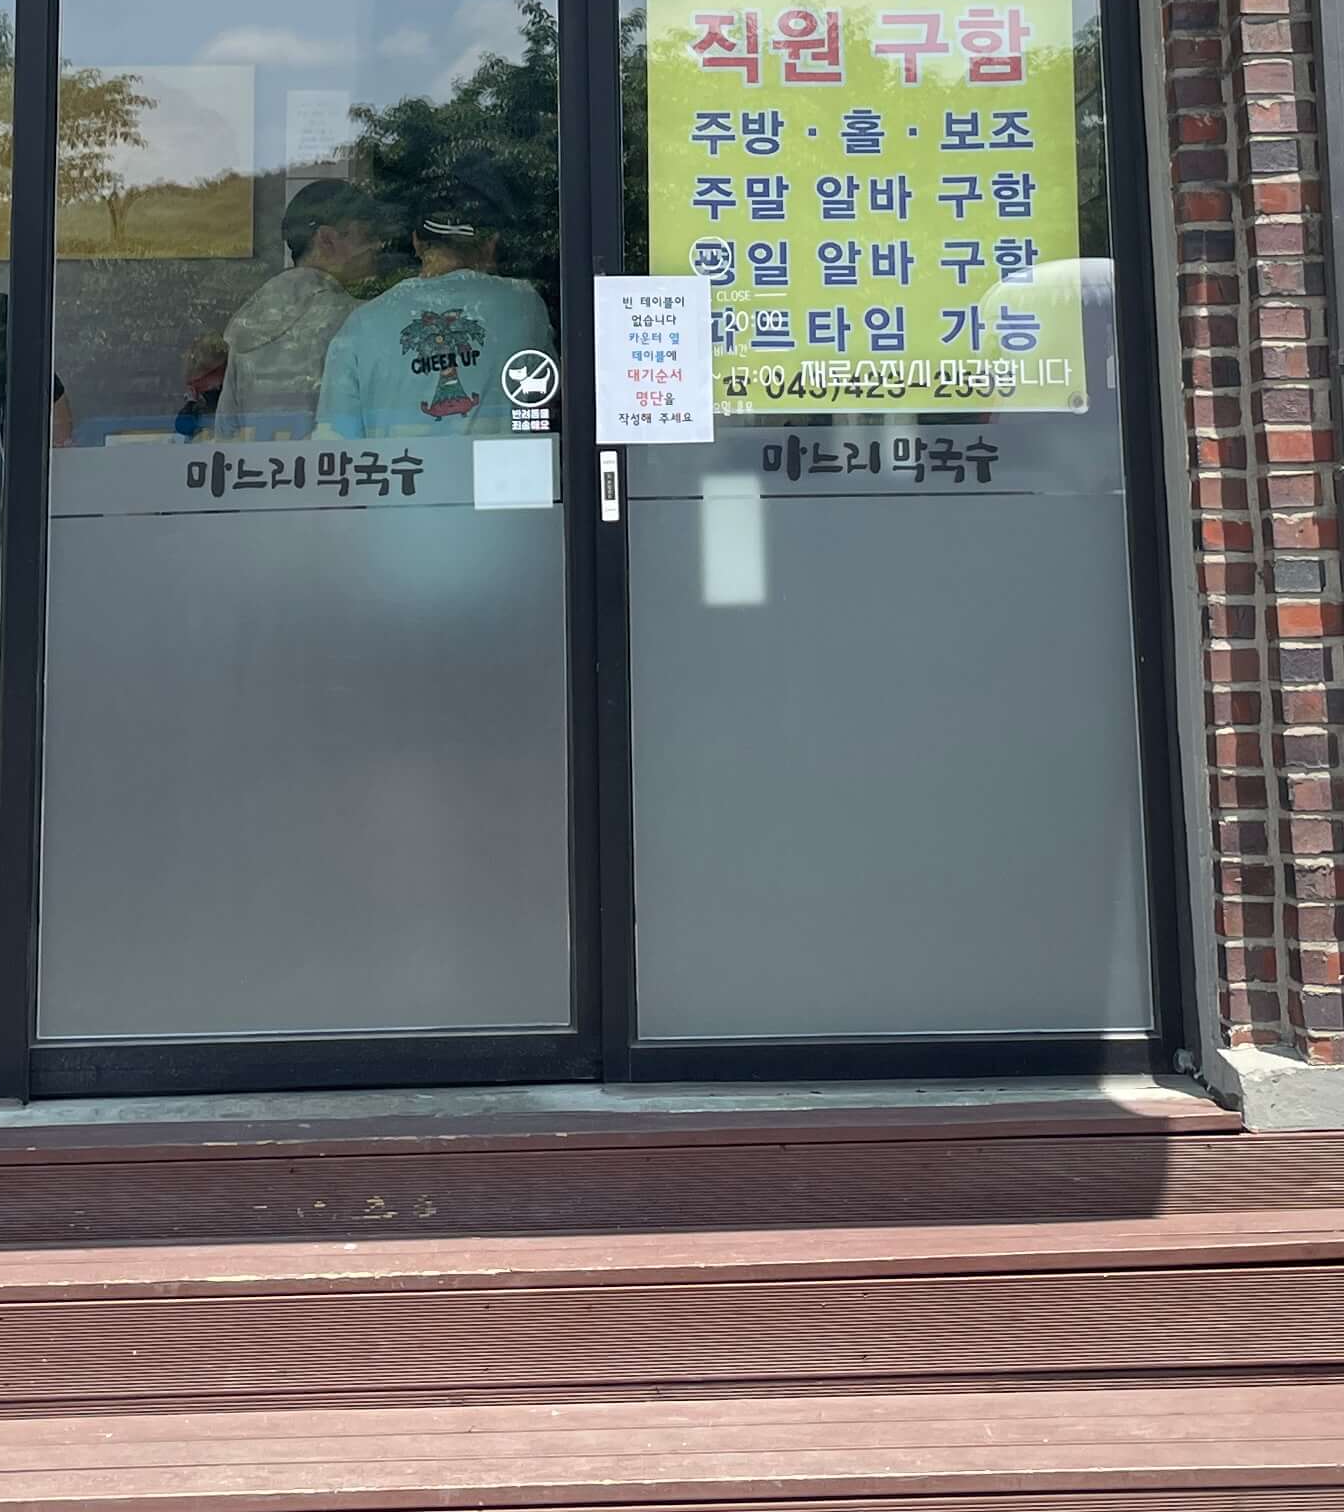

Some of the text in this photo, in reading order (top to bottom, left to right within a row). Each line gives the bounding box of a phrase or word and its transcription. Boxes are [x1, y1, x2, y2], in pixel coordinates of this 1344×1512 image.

[691, 7, 1032, 85] 직원 구함
[690, 109, 785, 156] 주방
[839, 108, 886, 155] 홀
[940, 110, 1036, 152] 보조
[691, 172, 1037, 221] 주말 알바 구함
[694, 237, 1039, 286] 평일 알바 구함
[622, 296, 685, 309] 빈 테이블이
[631, 315, 677, 327] 없습니다
[724, 310, 783, 333] 20:00
[940, 304, 1041, 351] 가능
[629, 332, 680, 345] 카운터 옆
[411, 350, 481, 375] CHEER UP
[632, 350, 677, 362] 테이블에
[627, 368, 683, 383] 대기순서
[939, 357, 1073, 388] 마감합니다
[635, 390, 676, 407] 명단을
[618, 412, 693, 426] 작성해 주세요
[762, 434, 1000, 484] 마느리 막국수
[187, 448, 424, 497] 마느리 막국수
